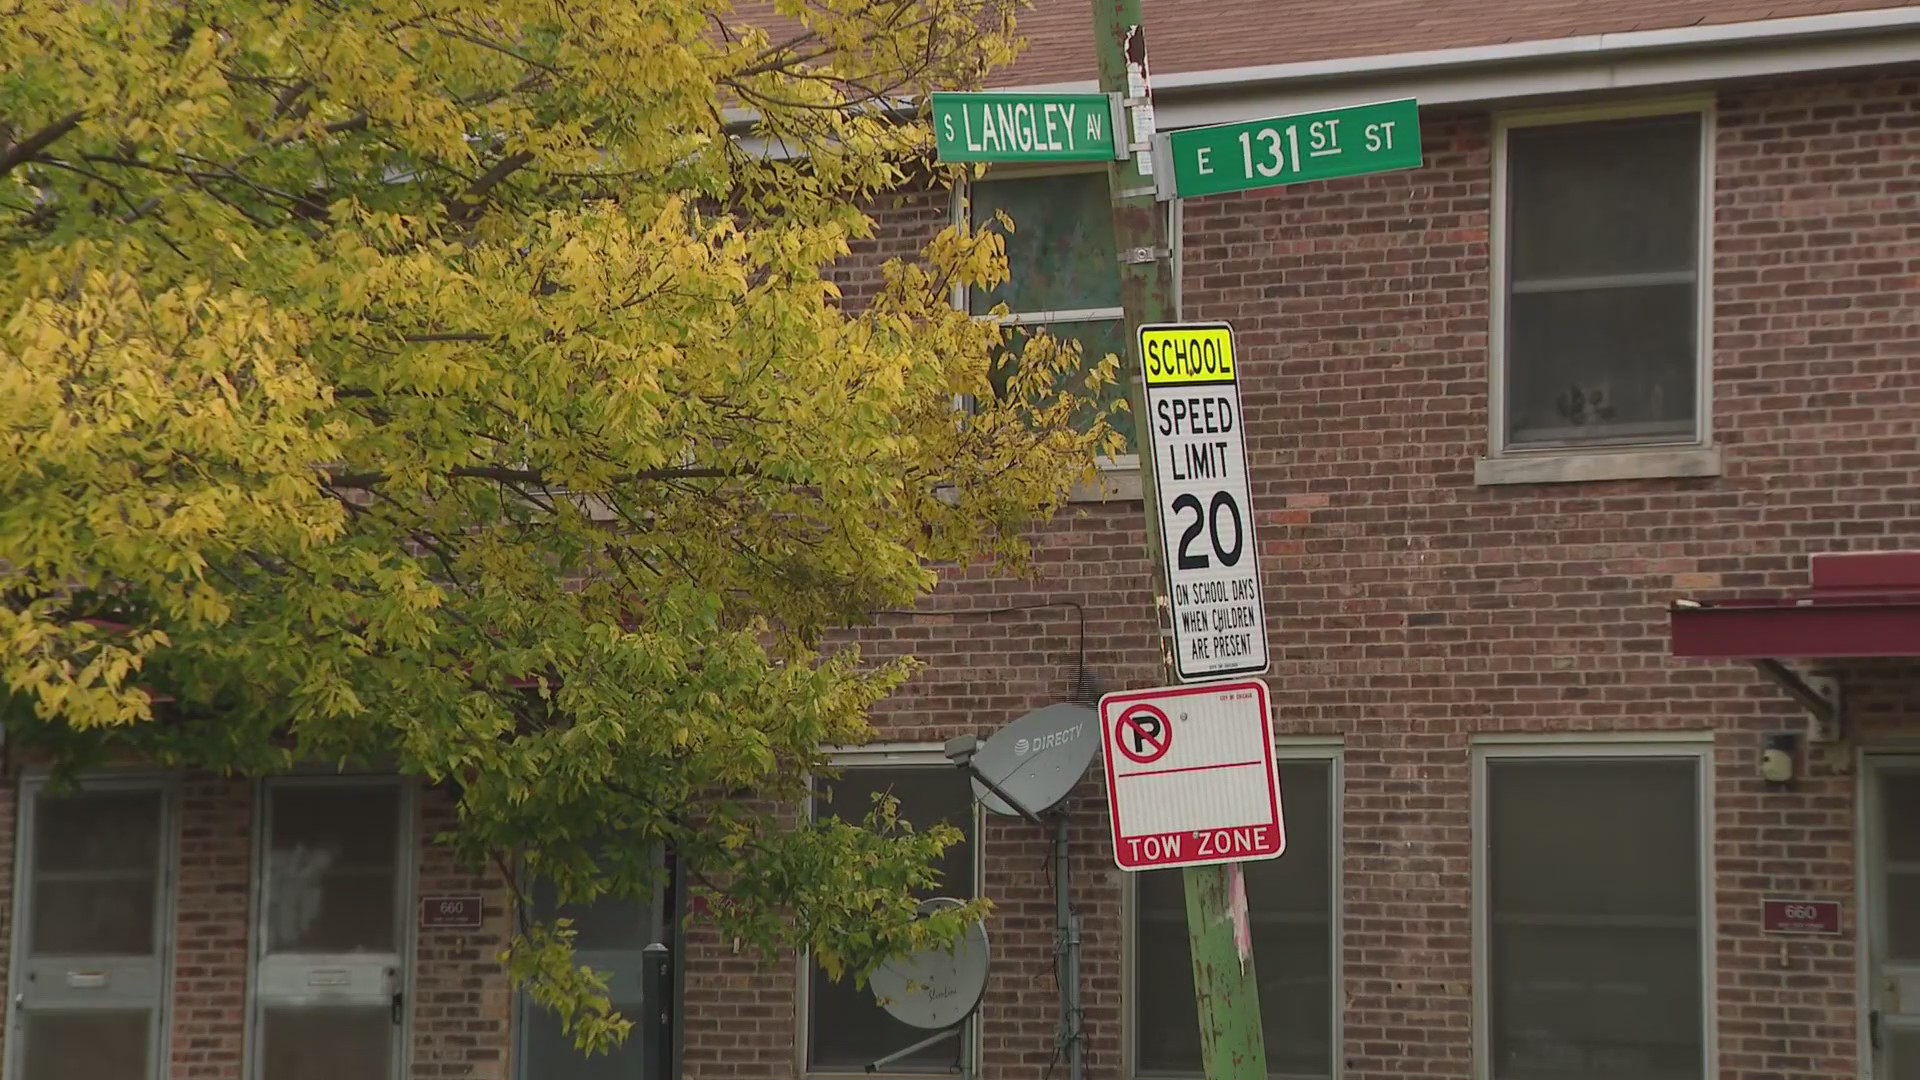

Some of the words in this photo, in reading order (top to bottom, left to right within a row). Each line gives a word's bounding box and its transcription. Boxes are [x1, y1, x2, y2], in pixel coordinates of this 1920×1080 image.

[943, 113, 955, 142] S
[962, 103, 1076, 151] LANGLEY
[1086, 113, 1101, 141] AV
[1197, 147, 1214, 175] E
[1364, 121, 1395, 152] ST
[1148, 338, 1231, 376] SCHOOL
[1157, 397, 1233, 436] SPEED
[1169, 441, 1228, 481] LIMIT
[1171, 490, 1243, 571] 20
[1175, 584, 1190, 606] ON
[1193, 580, 1229, 605] SCHOOL
[1231, 578, 1255, 602] DAYS
[1181, 609, 1208, 634] WHEN
[1212, 606, 1256, 633] CHILDREN
[1191, 638, 1210, 660] ARE
[1213, 634, 1252, 658] PRESENT
[1032, 722, 1084, 752] DIRECTV
[1127, 835, 1182, 862] TOW
[1197, 827, 1270, 856] ZONE
[440, 901, 464, 914] 660
[1785, 904, 1817, 919] 660
